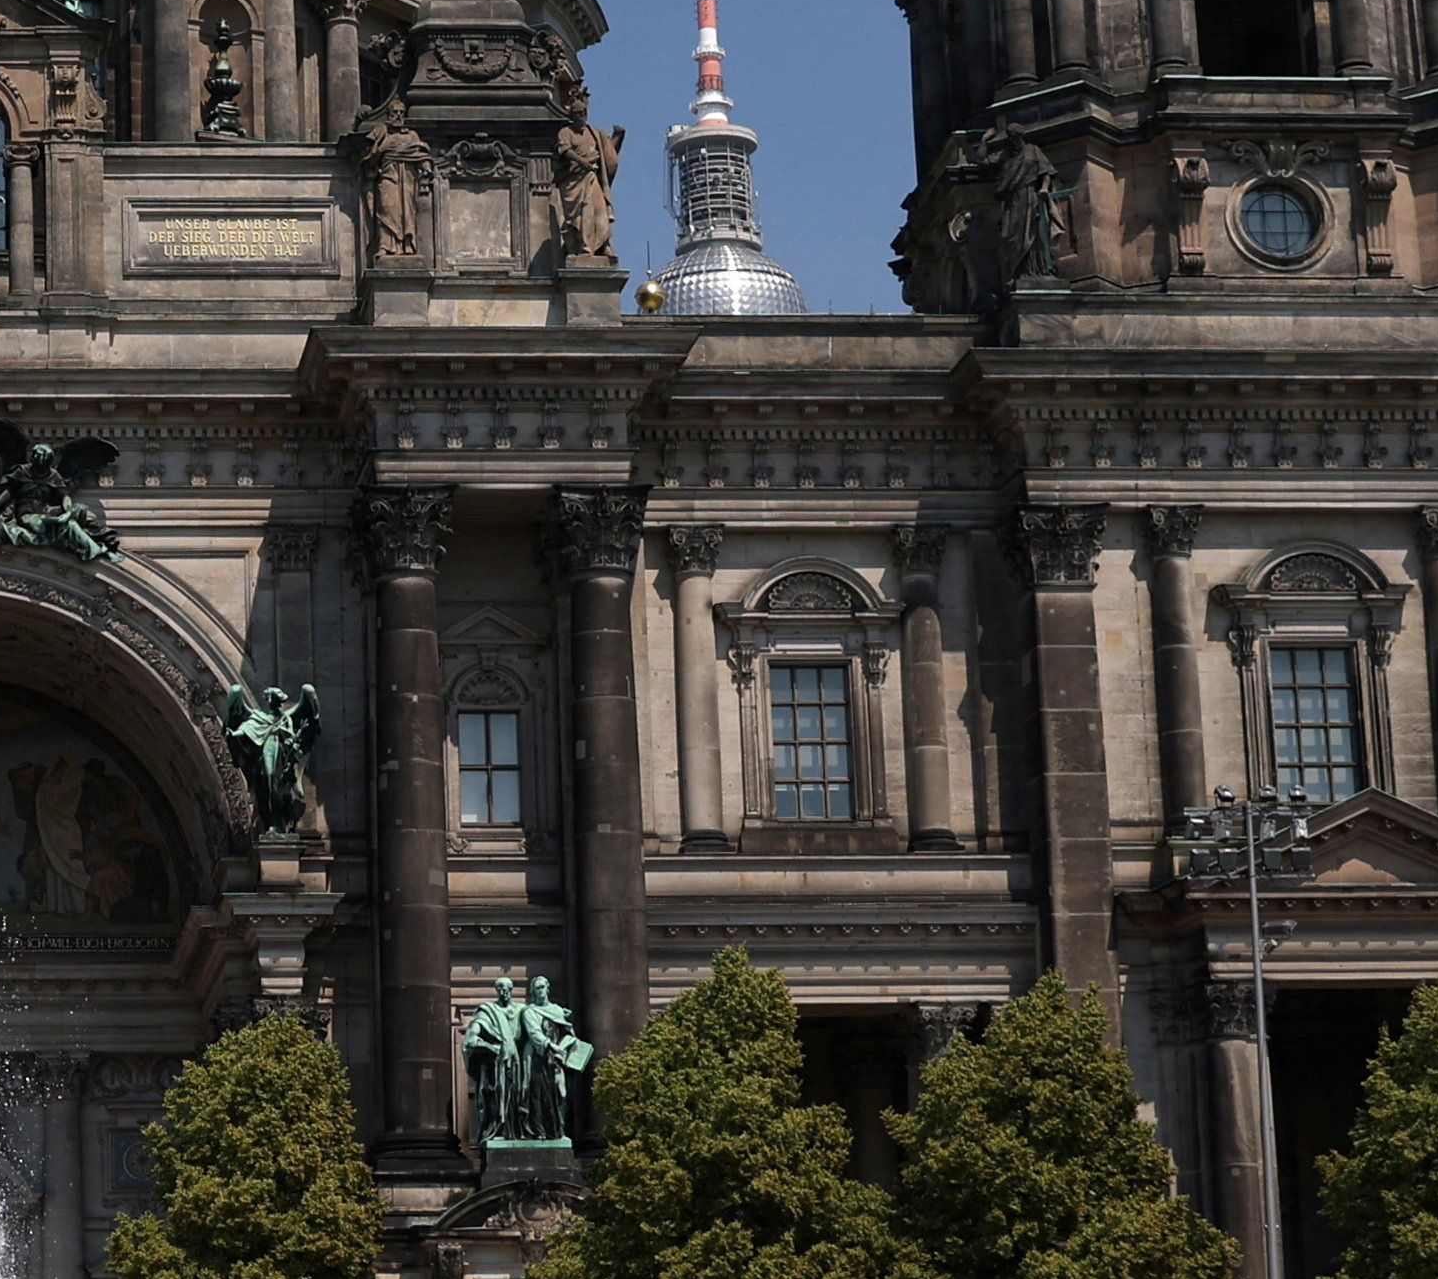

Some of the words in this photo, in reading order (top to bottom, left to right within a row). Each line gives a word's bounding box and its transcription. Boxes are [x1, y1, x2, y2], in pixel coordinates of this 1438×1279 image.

[165, 218, 211, 230] UNSER
[216, 218, 271, 230] GLAUBE
[276, 218, 298, 230] IST
[148, 231, 176, 243] DER
[219, 231, 247, 243] DER
[252, 231, 275, 243] DIE
[279, 231, 315, 243] WELT
[163, 244, 269, 257] UEBERWUNDEN
[274, 244, 302, 257] HAT.
